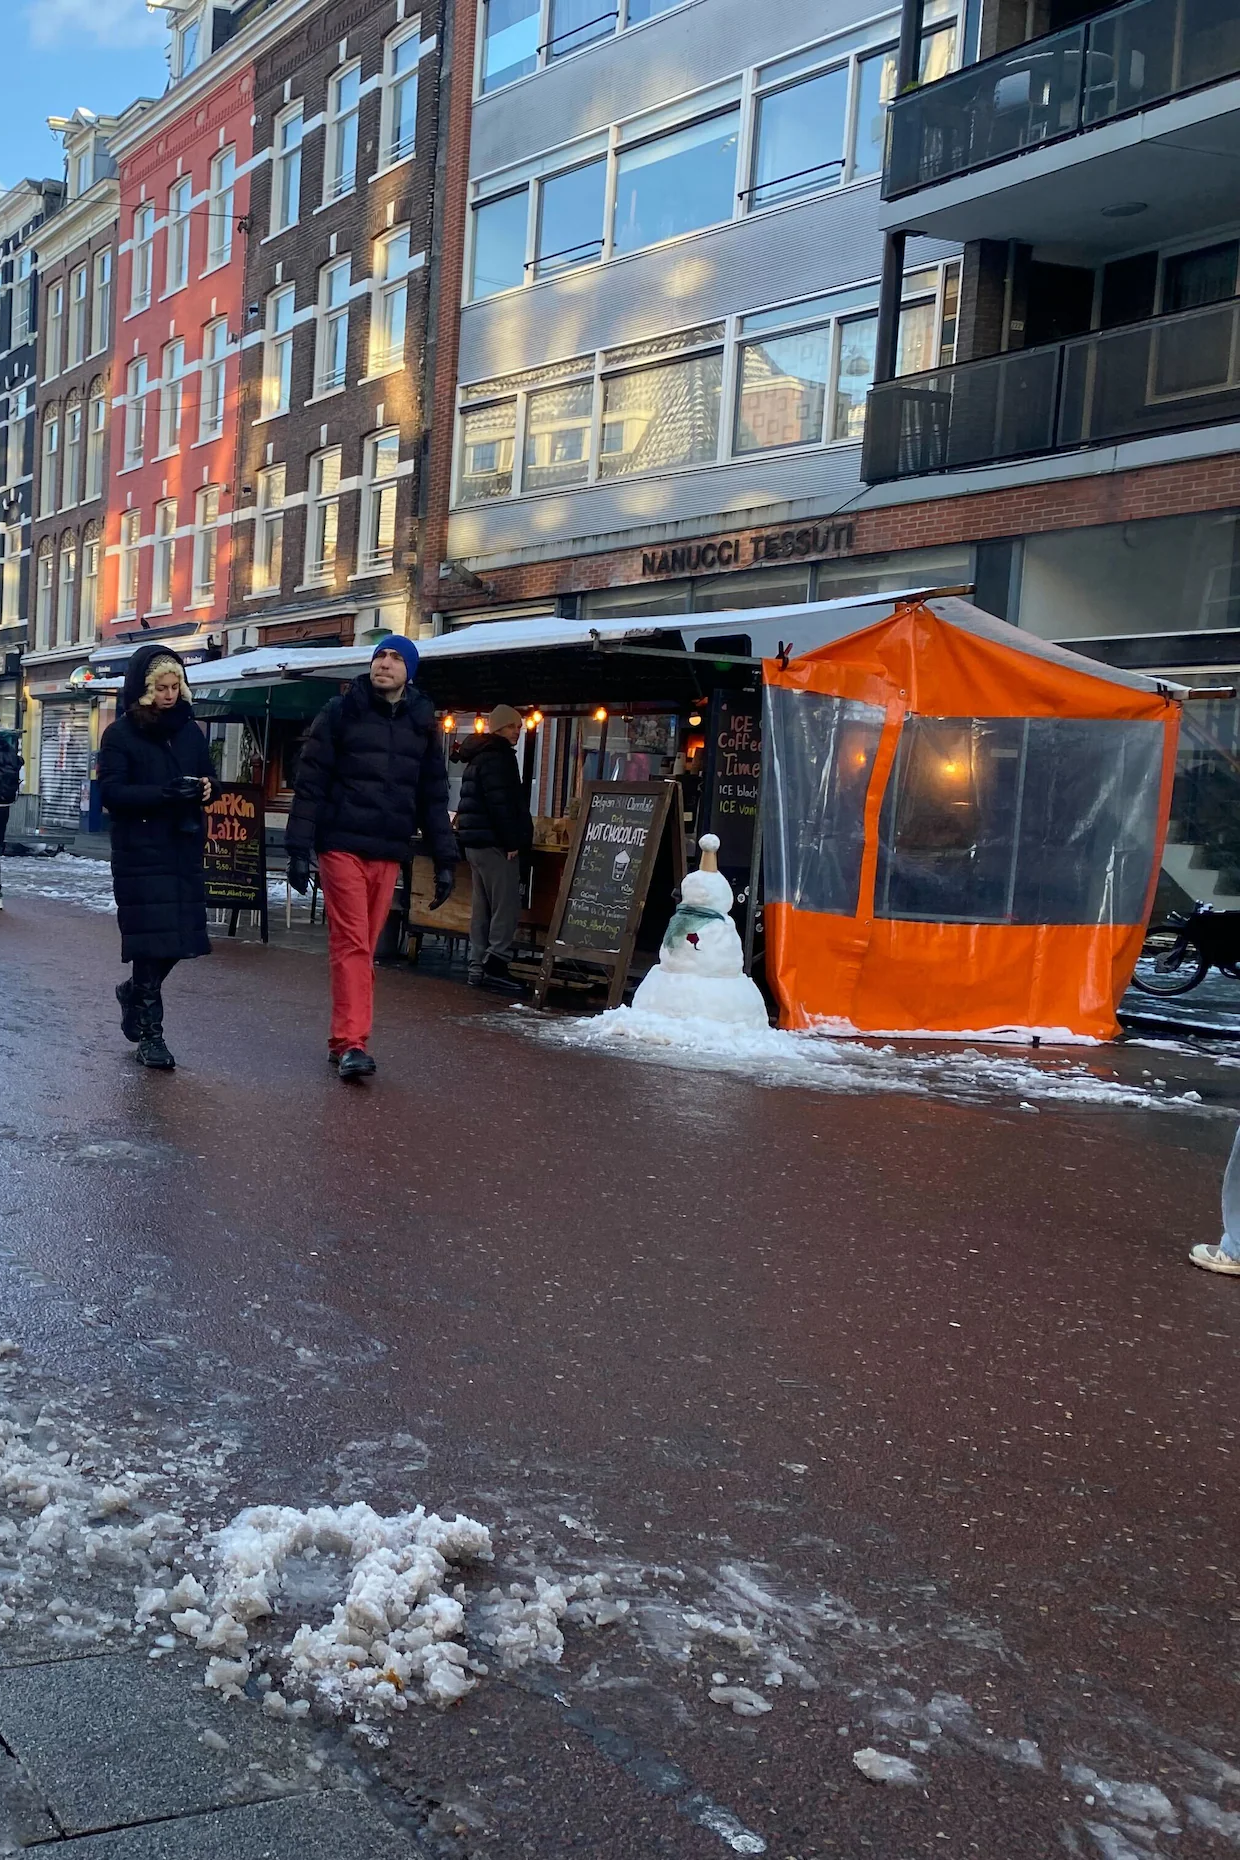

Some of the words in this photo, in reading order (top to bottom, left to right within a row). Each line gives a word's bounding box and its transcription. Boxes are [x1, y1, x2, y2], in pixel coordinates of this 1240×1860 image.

[642, 539, 740, 576] NANUCCI
[750, 522, 853, 560] TESSUTI
[731, 716, 752, 732] ICE
[723, 752, 760, 778] Time
[719, 785, 733, 796] ICE
[719, 800, 736, 813] ICE
[739, 805, 757, 815] vani
[207, 815, 247, 841] Latte
[585, 823, 606, 841] HOT
[603, 824, 648, 847] CHOCOLATE
